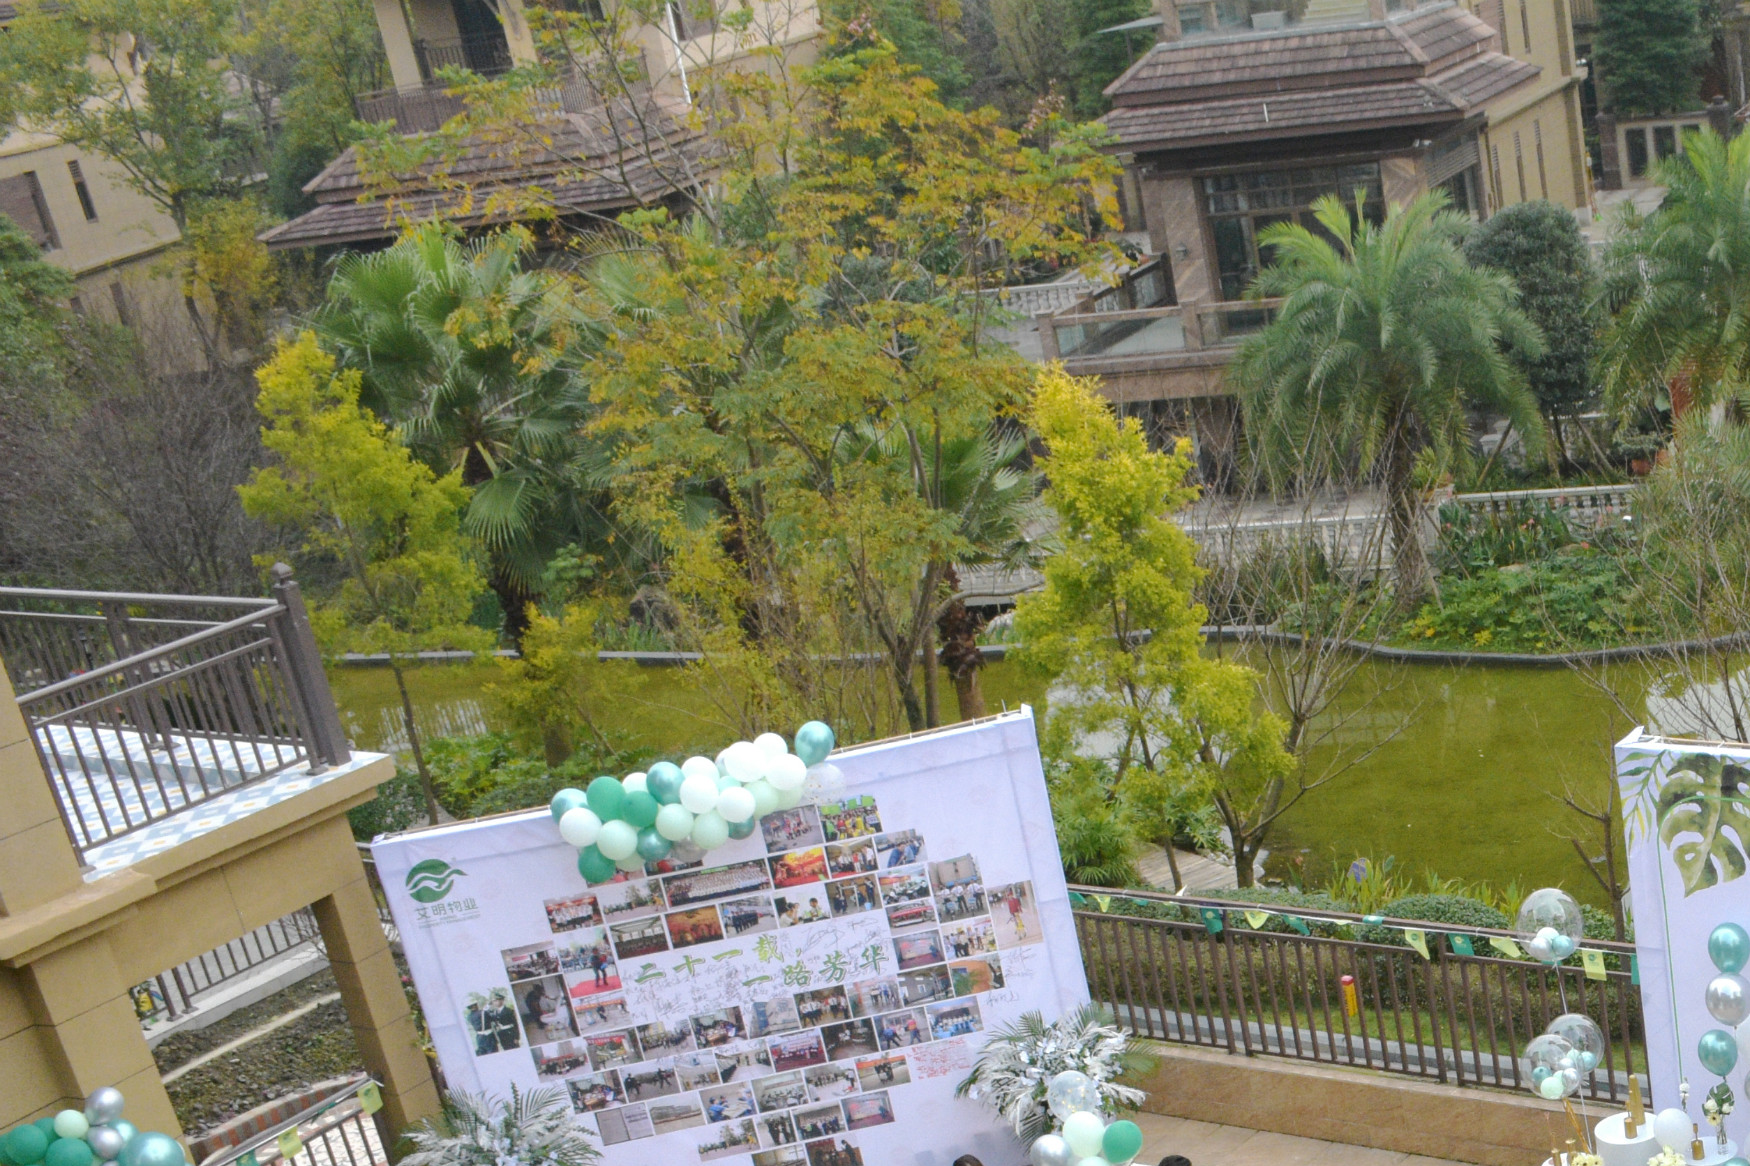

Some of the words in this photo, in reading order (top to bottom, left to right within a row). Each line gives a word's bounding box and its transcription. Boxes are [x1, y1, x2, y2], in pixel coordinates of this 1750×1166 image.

[415, 897, 479, 920] 艾明物业
[743, 943, 889, 988] 一路芳华
